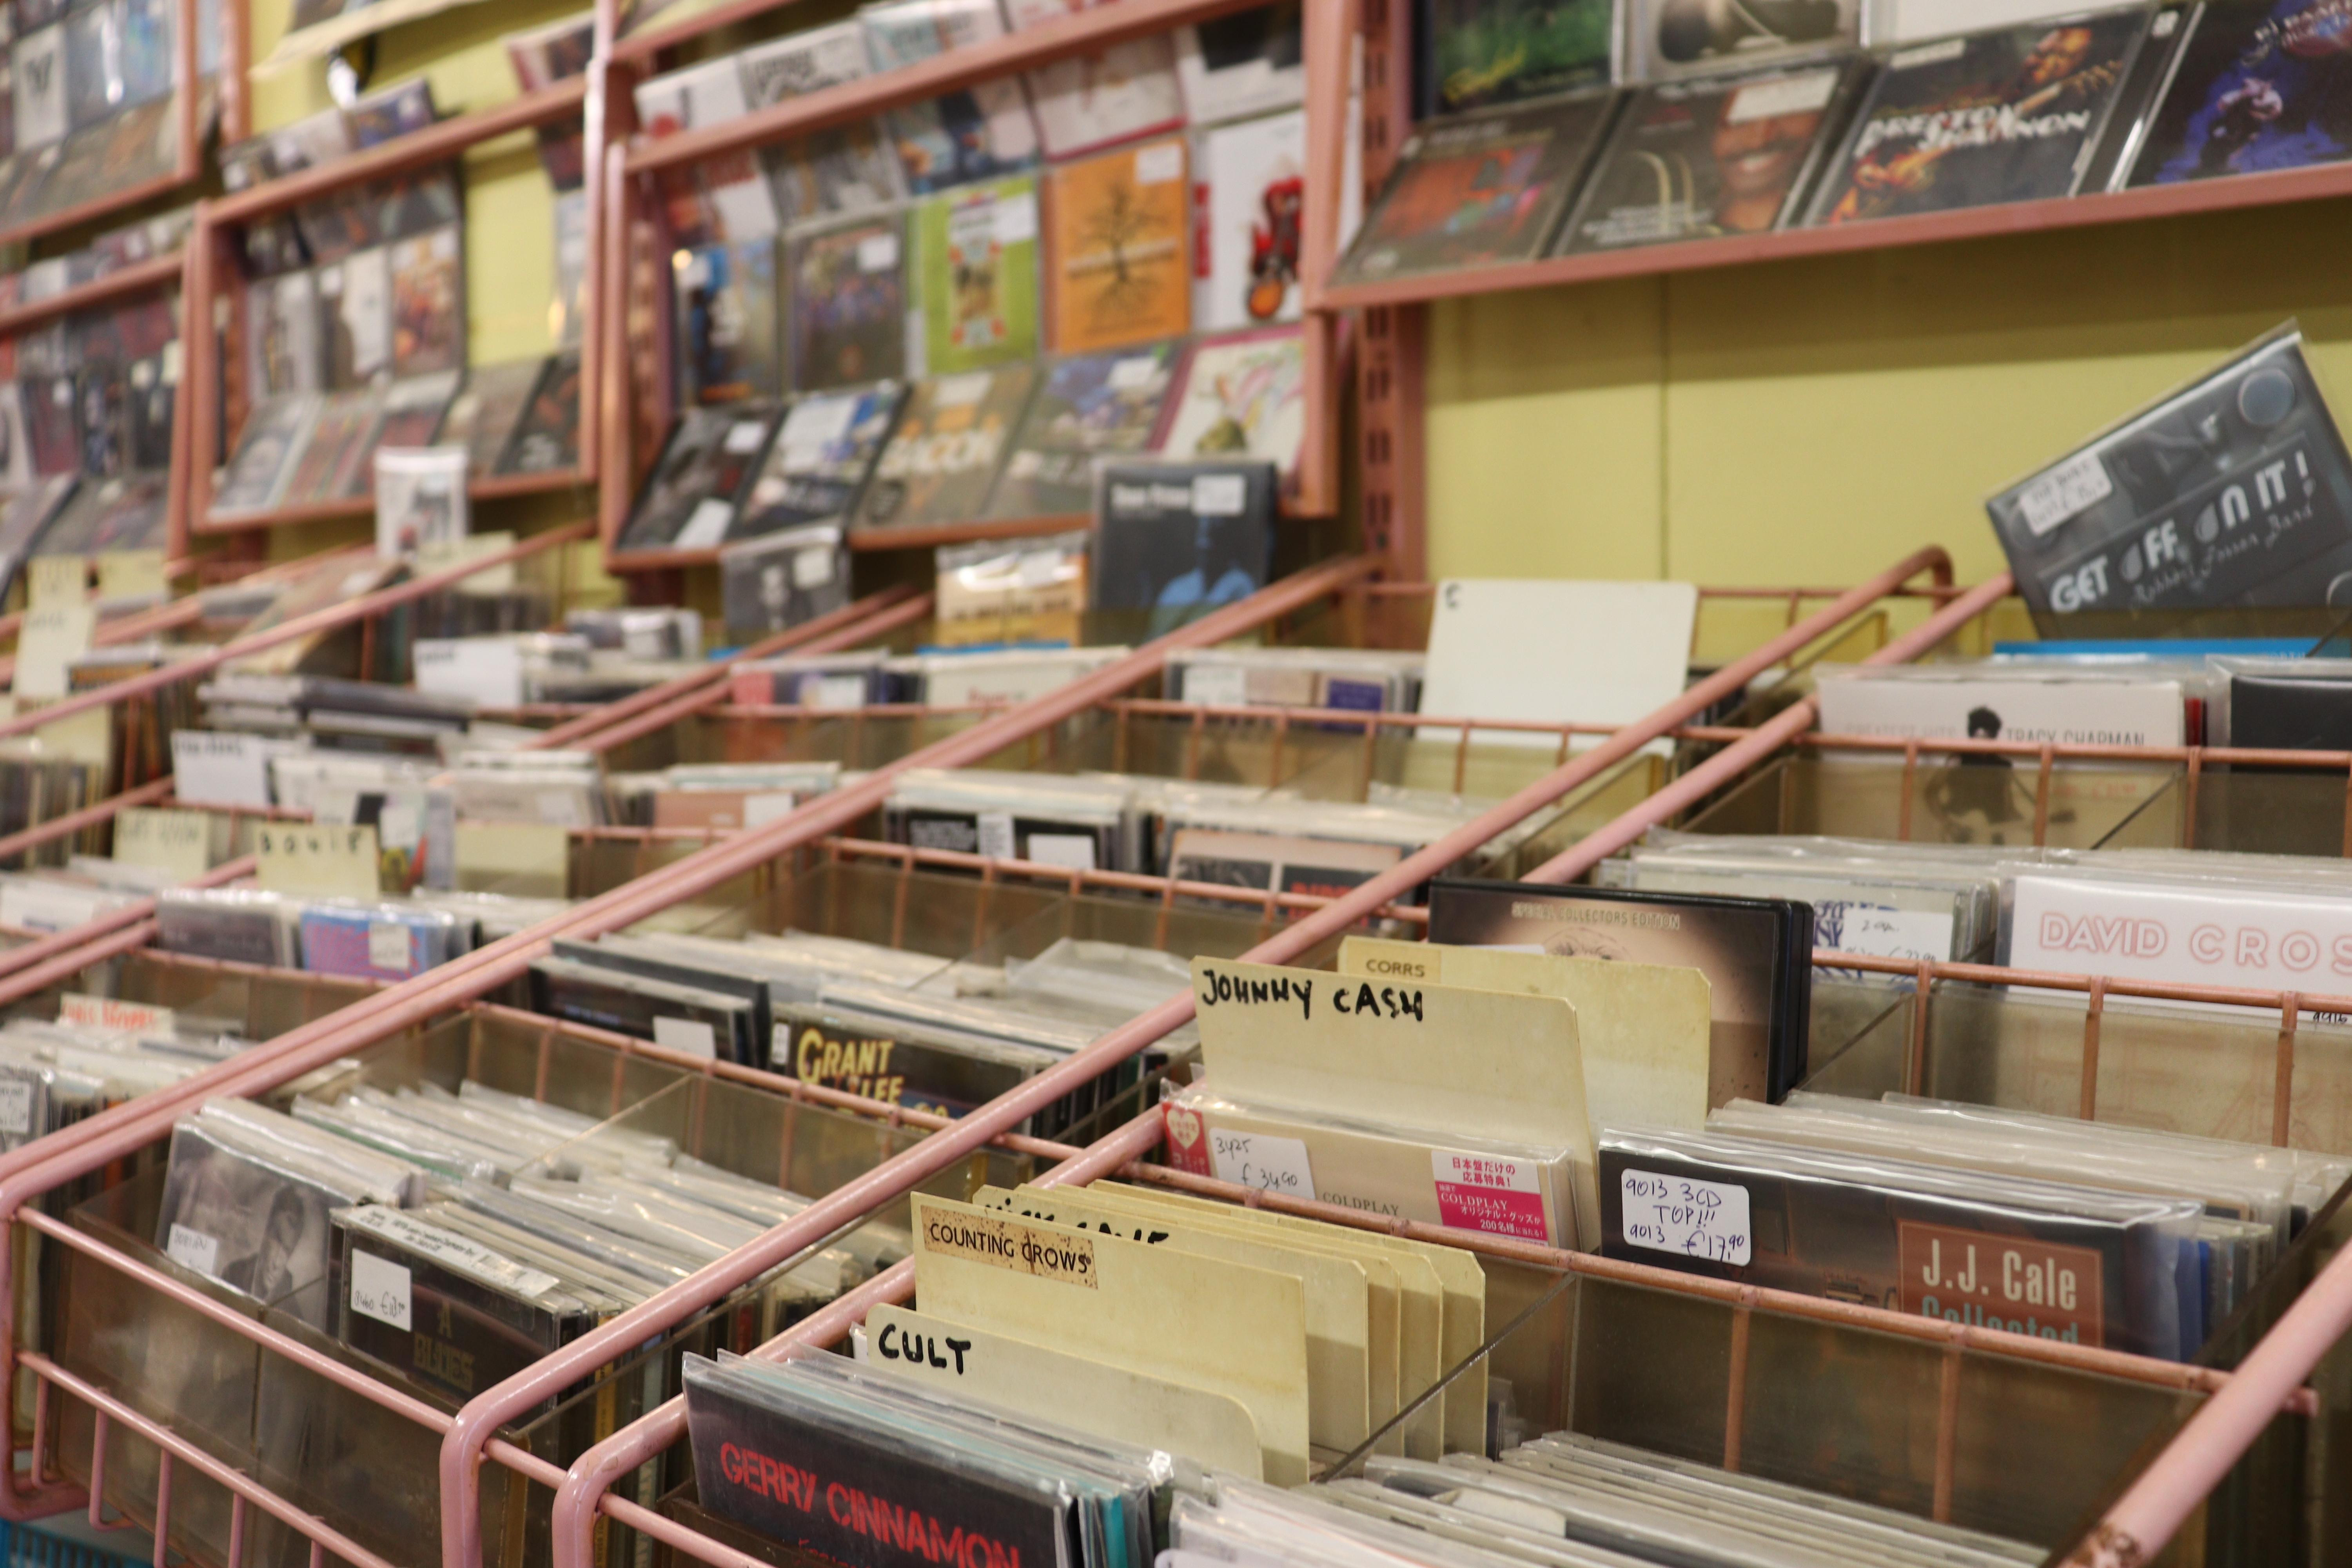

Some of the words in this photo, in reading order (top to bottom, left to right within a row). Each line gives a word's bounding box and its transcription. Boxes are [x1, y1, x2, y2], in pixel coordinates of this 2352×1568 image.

[2049, 554, 2109, 614] GET
[1511, 902, 1554, 920] SPECIAL
[1558, 906, 1628, 926] COLLECTORS
[1632, 912, 1680, 930] EDITION
[2040, 912, 2168, 958] DAVID
[1366, 959, 1425, 978] CORRS
[1202, 968, 1312, 1020] JOHNNY
[1333, 983, 1423, 1022] CASH
[797, 1027, 895, 1084] GRANT
[1452, 1157, 1515, 1175] 日本盤だけの
[1626, 1178, 1668, 1199] 9013
[1323, 1191, 1399, 1216] COLDPLAY
[1441, 1192, 1508, 1211] COLDPLAY
[930, 1223, 1014, 1258] COUNTING
[1022, 1241, 1088, 1274] CROWS
[1923, 1238, 1989, 1296] J.J.
[2002, 1250, 2076, 1311] Cale
[878, 1323, 971, 1375] CULT
[720, 1441, 817, 1513] GERRY
[826, 1481, 1020, 1568] CINNAMON
